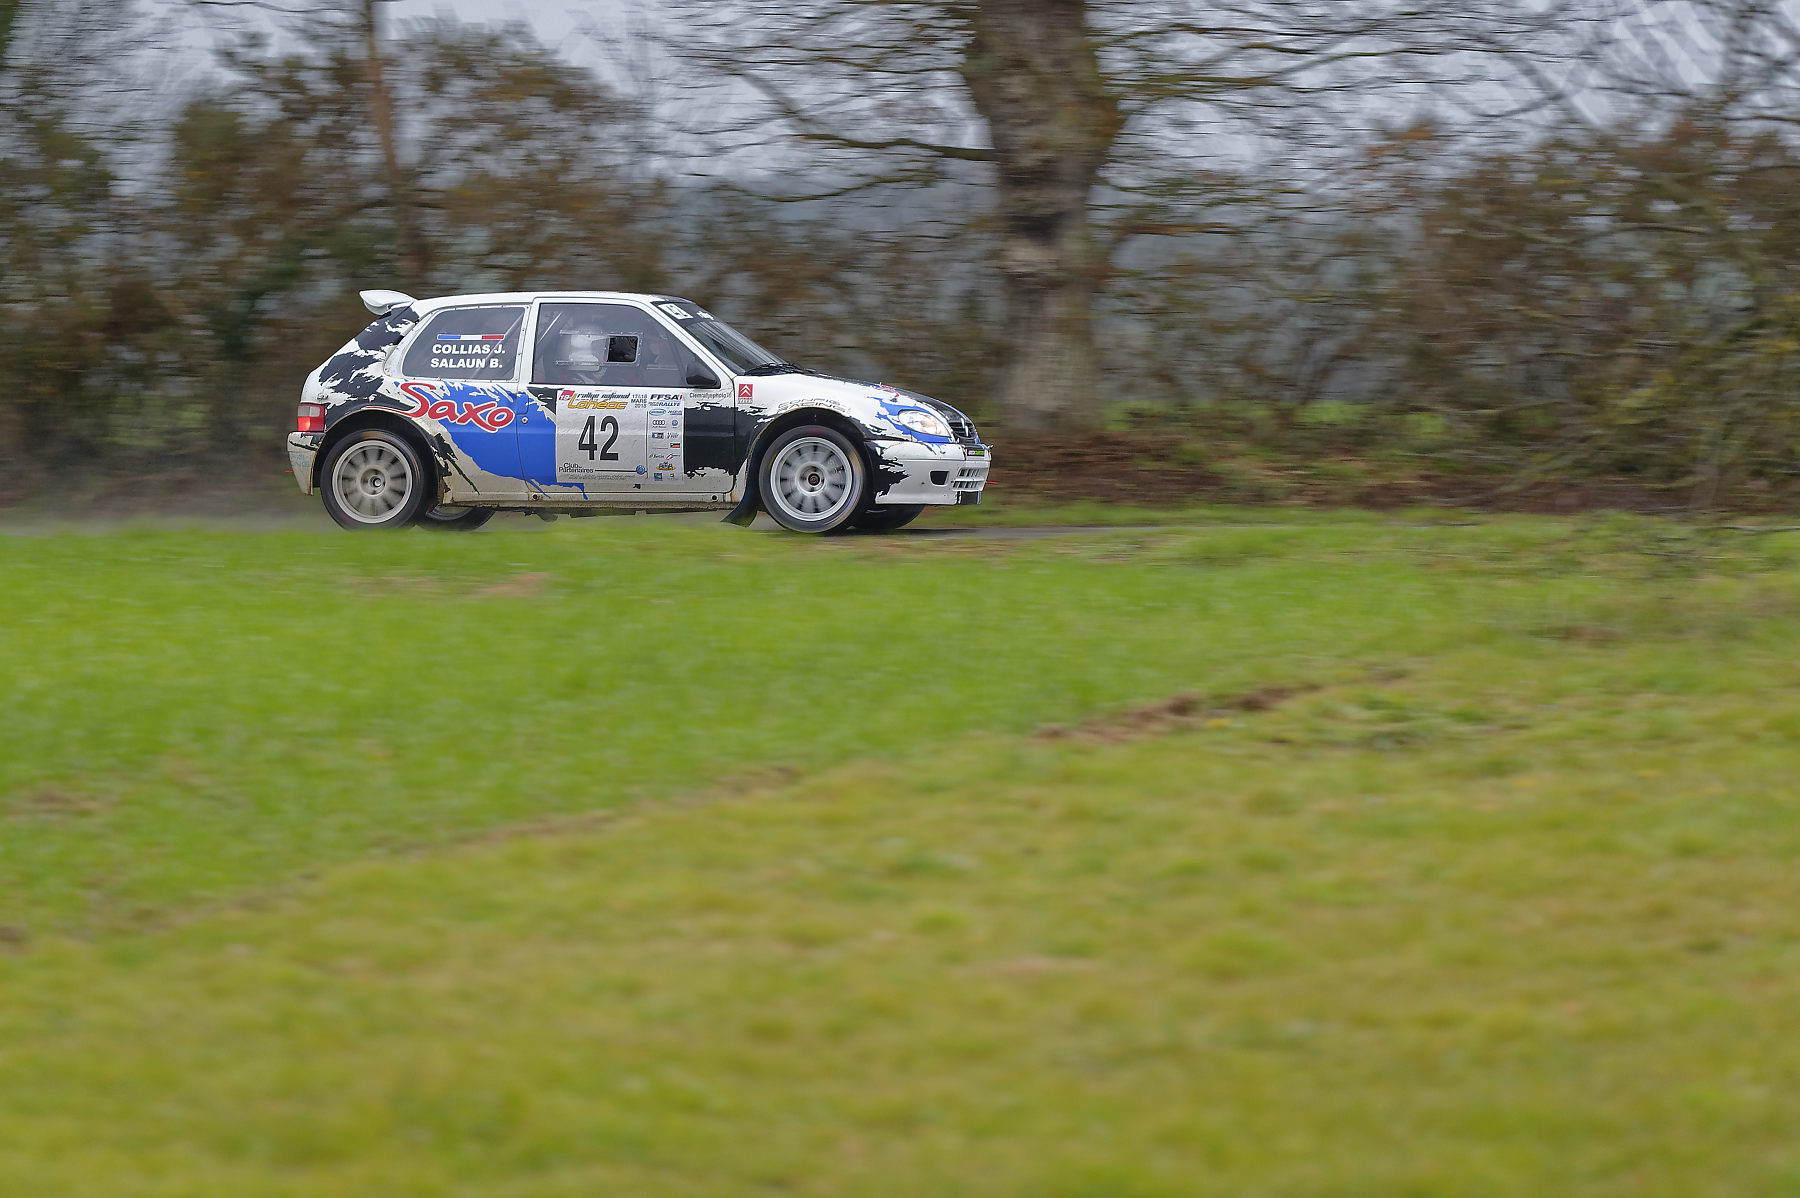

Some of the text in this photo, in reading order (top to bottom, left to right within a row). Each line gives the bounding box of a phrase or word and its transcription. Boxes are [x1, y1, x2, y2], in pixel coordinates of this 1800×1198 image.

[432, 344, 506, 354] COLLIAS J.
[430, 358, 503, 368] SALAUN B.
[577, 392, 631, 400] rallye national
[568, 393, 629, 410] Lohéac
[400, 382, 515, 433] Saxo
[578, 415, 619, 461] 42
[558, 466, 595, 474] Partenaires
